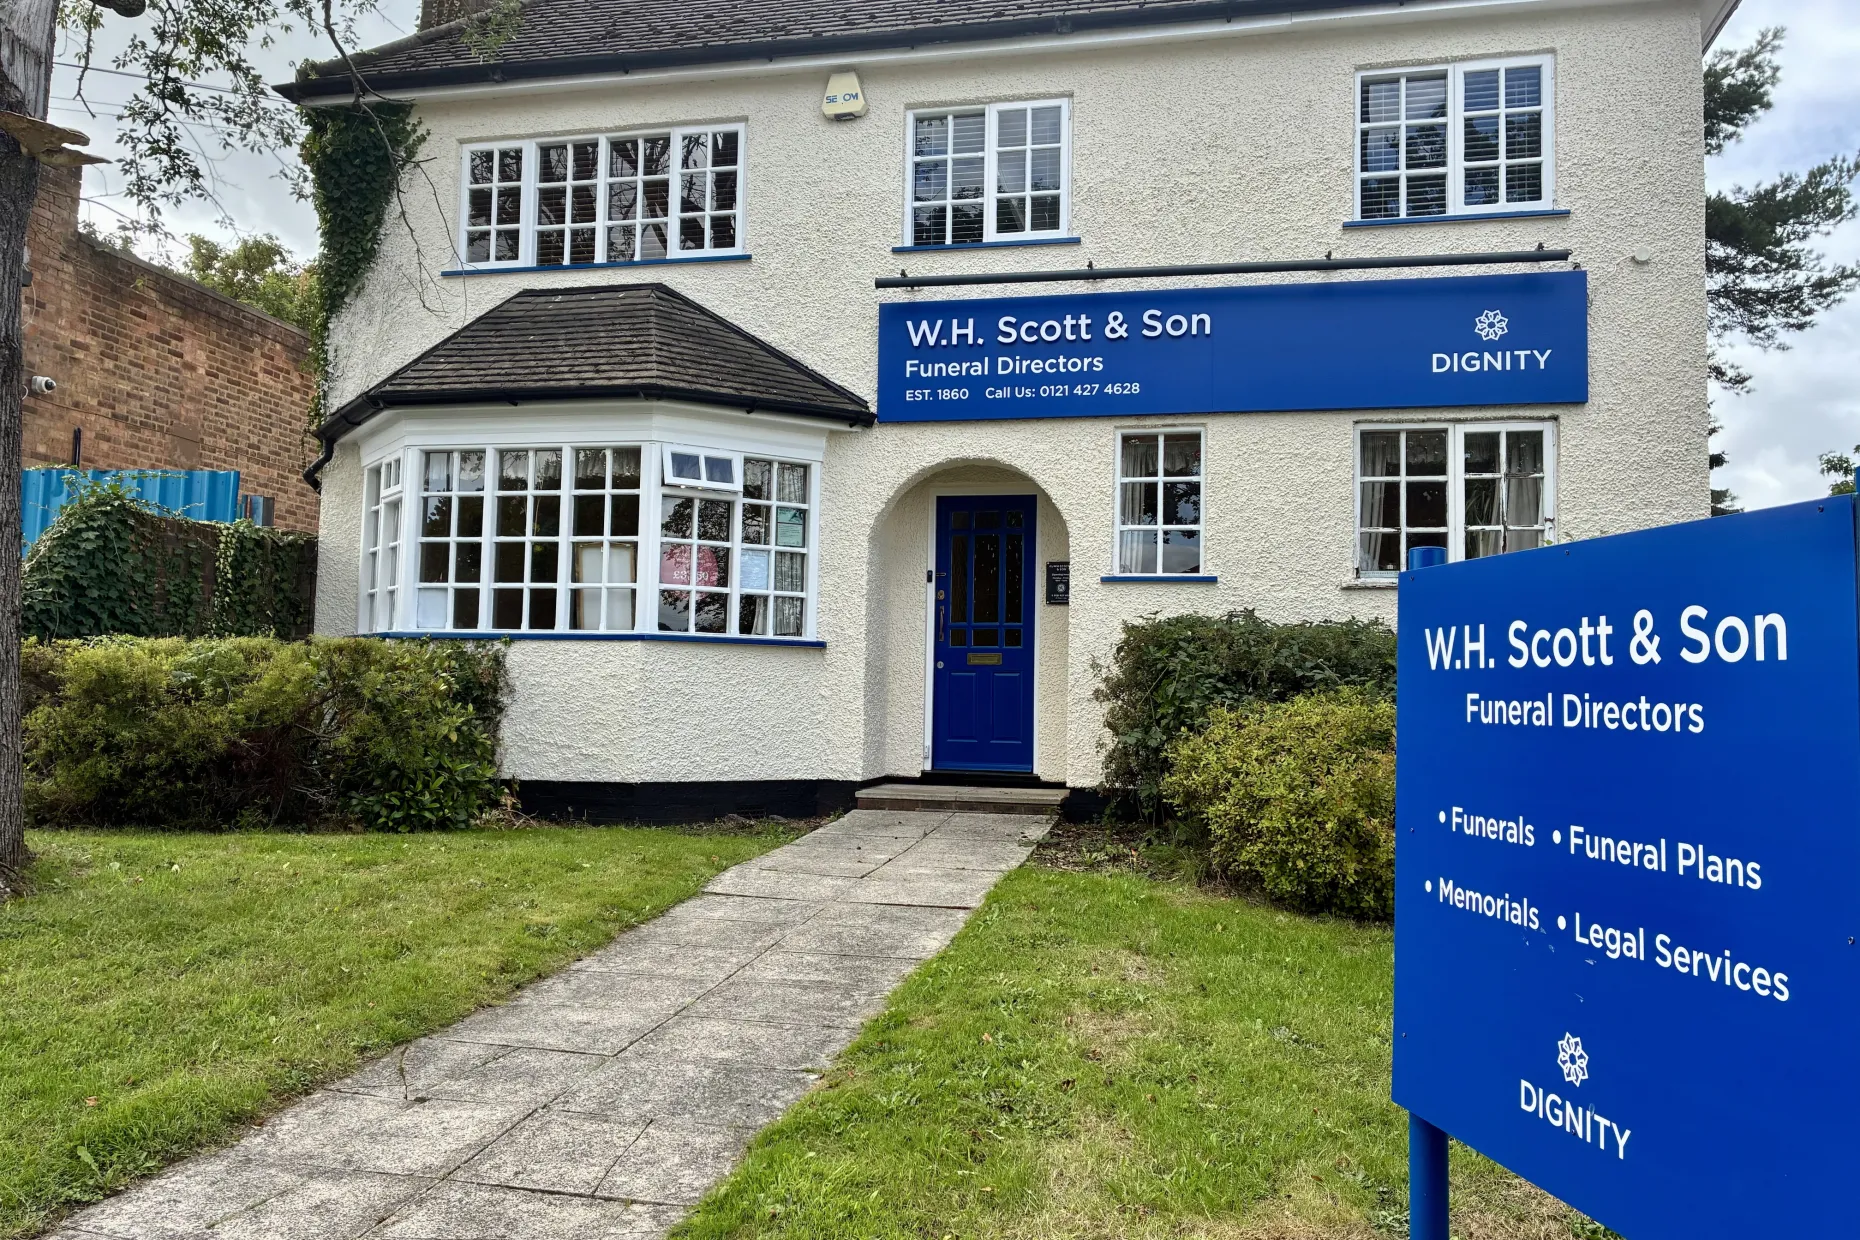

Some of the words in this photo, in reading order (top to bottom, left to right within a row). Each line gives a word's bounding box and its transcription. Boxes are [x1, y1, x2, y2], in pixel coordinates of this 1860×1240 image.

[906, 317, 985, 347] W.H.
[996, 313, 1092, 344] Scott
[1104, 310, 1129, 339] &
[1141, 309, 1212, 337] Son
[905, 356, 989, 378] Funeral
[997, 355, 1104, 375] Directors
[1432, 349, 1552, 373] DIGNITY
[905, 389, 933, 401] EST.
[937, 388, 969, 400] 1860
[985, 386, 1011, 399] Call
[1014, 386, 1036, 398] Us:
[1039, 384, 1069, 397] 0121
[1073, 383, 1100, 396] 427
[1103, 382, 1140, 395] 4628
[1425, 623, 1495, 671] W.H.
[1507, 615, 1614, 669] Scott
[1629, 608, 1662, 665] &
[1679, 604, 1788, 664] Son
[1466, 692, 1553, 727] Funeral
[1563, 692, 1705, 734] Directors
[1452, 806, 1535, 847] Funerals
[1569, 824, 1667, 872] Funeral
[1677, 842, 1762, 890] Plans
[1439, 877, 1540, 930] Memorials
[1575, 911, 1645, 961] Legal
[1655, 933, 1790, 1002] Services
[1520, 1079, 1632, 1160] DIGNITY
